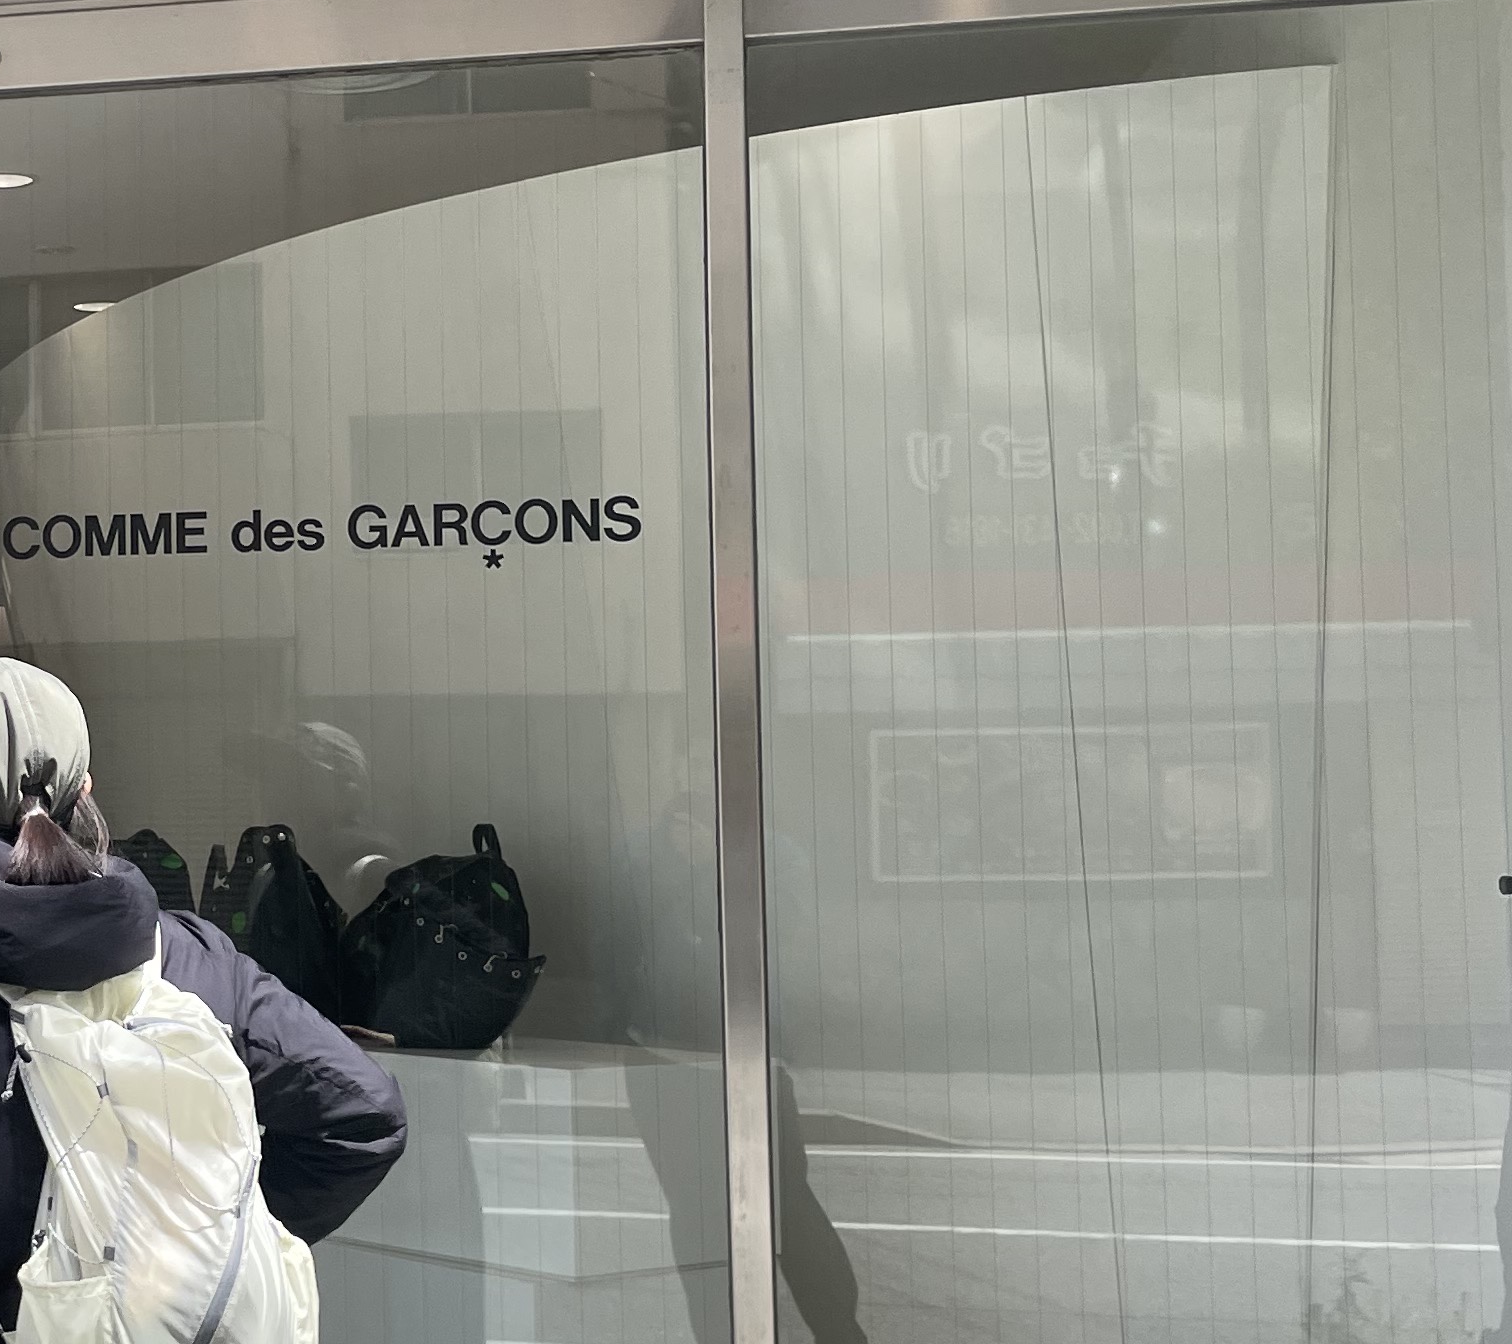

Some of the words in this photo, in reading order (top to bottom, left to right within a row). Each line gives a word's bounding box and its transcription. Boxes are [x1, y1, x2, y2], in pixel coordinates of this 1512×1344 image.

[2, 511, 208, 560] COMME
[231, 510, 325, 553] des
[348, 495, 642, 569] GARÇONS
